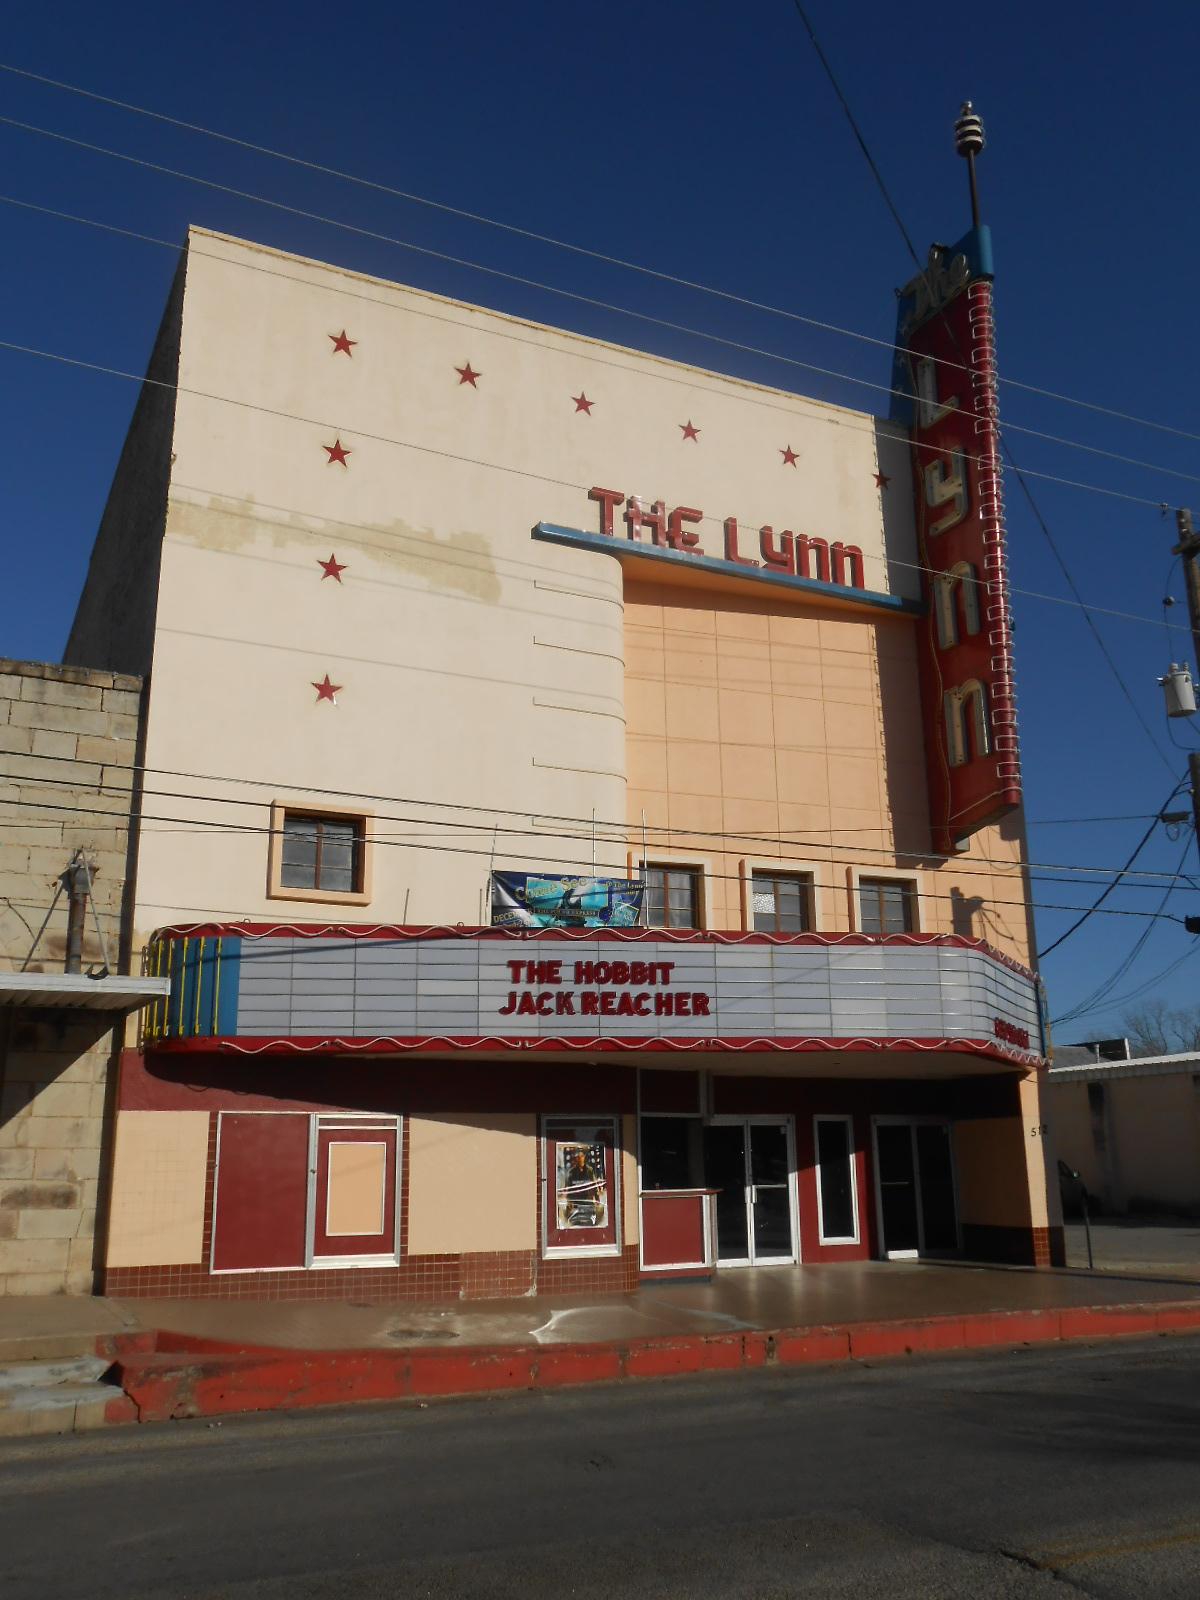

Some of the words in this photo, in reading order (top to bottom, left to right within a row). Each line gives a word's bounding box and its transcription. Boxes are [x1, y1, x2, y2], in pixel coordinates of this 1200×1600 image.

[588, 487, 704, 556] THE
[507, 960, 562, 984] THE
[574, 960, 675, 985] HOBBIT
[498, 991, 576, 1016] JACK
[580, 991, 711, 1017] REACHER
